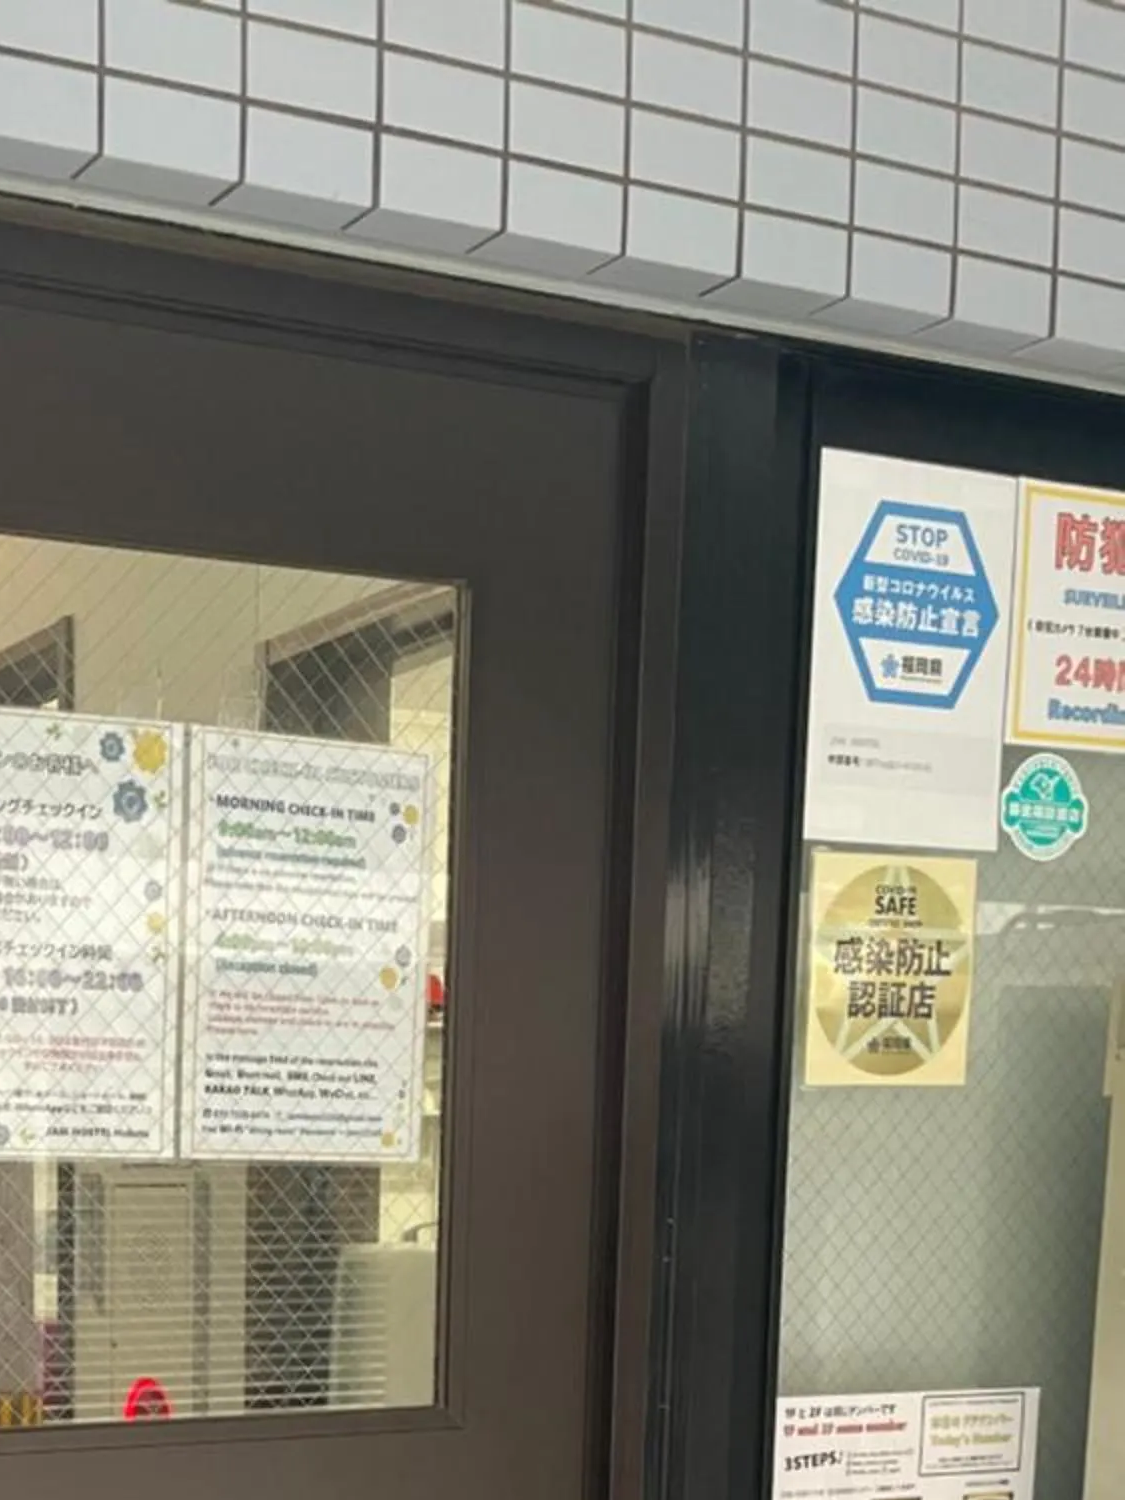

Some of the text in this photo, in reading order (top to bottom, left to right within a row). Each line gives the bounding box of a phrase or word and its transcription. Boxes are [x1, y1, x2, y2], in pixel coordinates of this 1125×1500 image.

[896, 524, 948, 547] STOP
[893, 547, 950, 566] COVID-19
[862, 573, 975, 603] 新型コロナウイルス
[851, 595, 981, 638] 感染防止宣言
[216, 794, 285, 815] MORNING
[347, 808, 375, 823] TIME
[212, 908, 298, 926] AFTERNOON
[875, 895, 917, 915] SAFE
[834, 936, 952, 977] 感染防止
[848, 981, 936, 1019] 認証店
